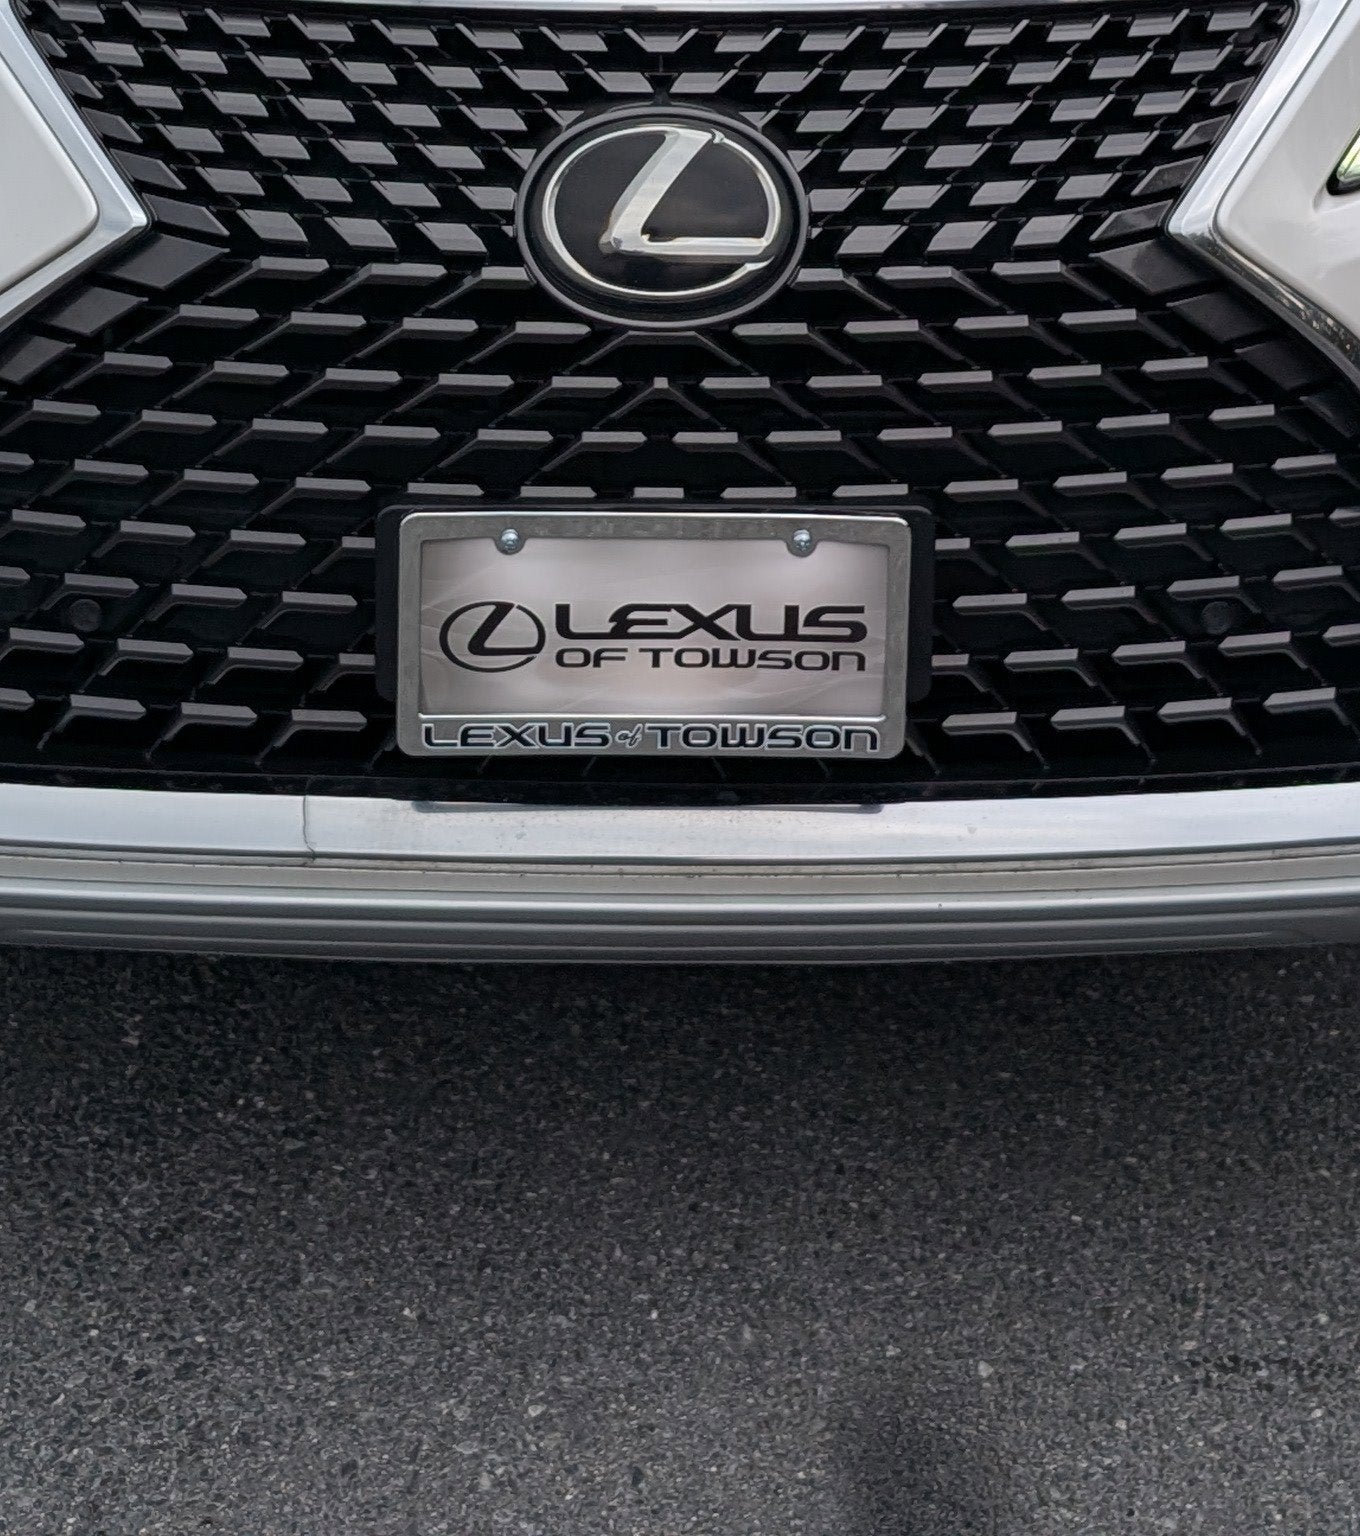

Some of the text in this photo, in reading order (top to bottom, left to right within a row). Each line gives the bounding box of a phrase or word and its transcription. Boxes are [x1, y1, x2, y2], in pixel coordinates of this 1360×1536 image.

[555, 602, 869, 643] LEXUS
[555, 647, 867, 672] OF TOWSON
[421, 723, 881, 753] LEXUS of TOWSON
